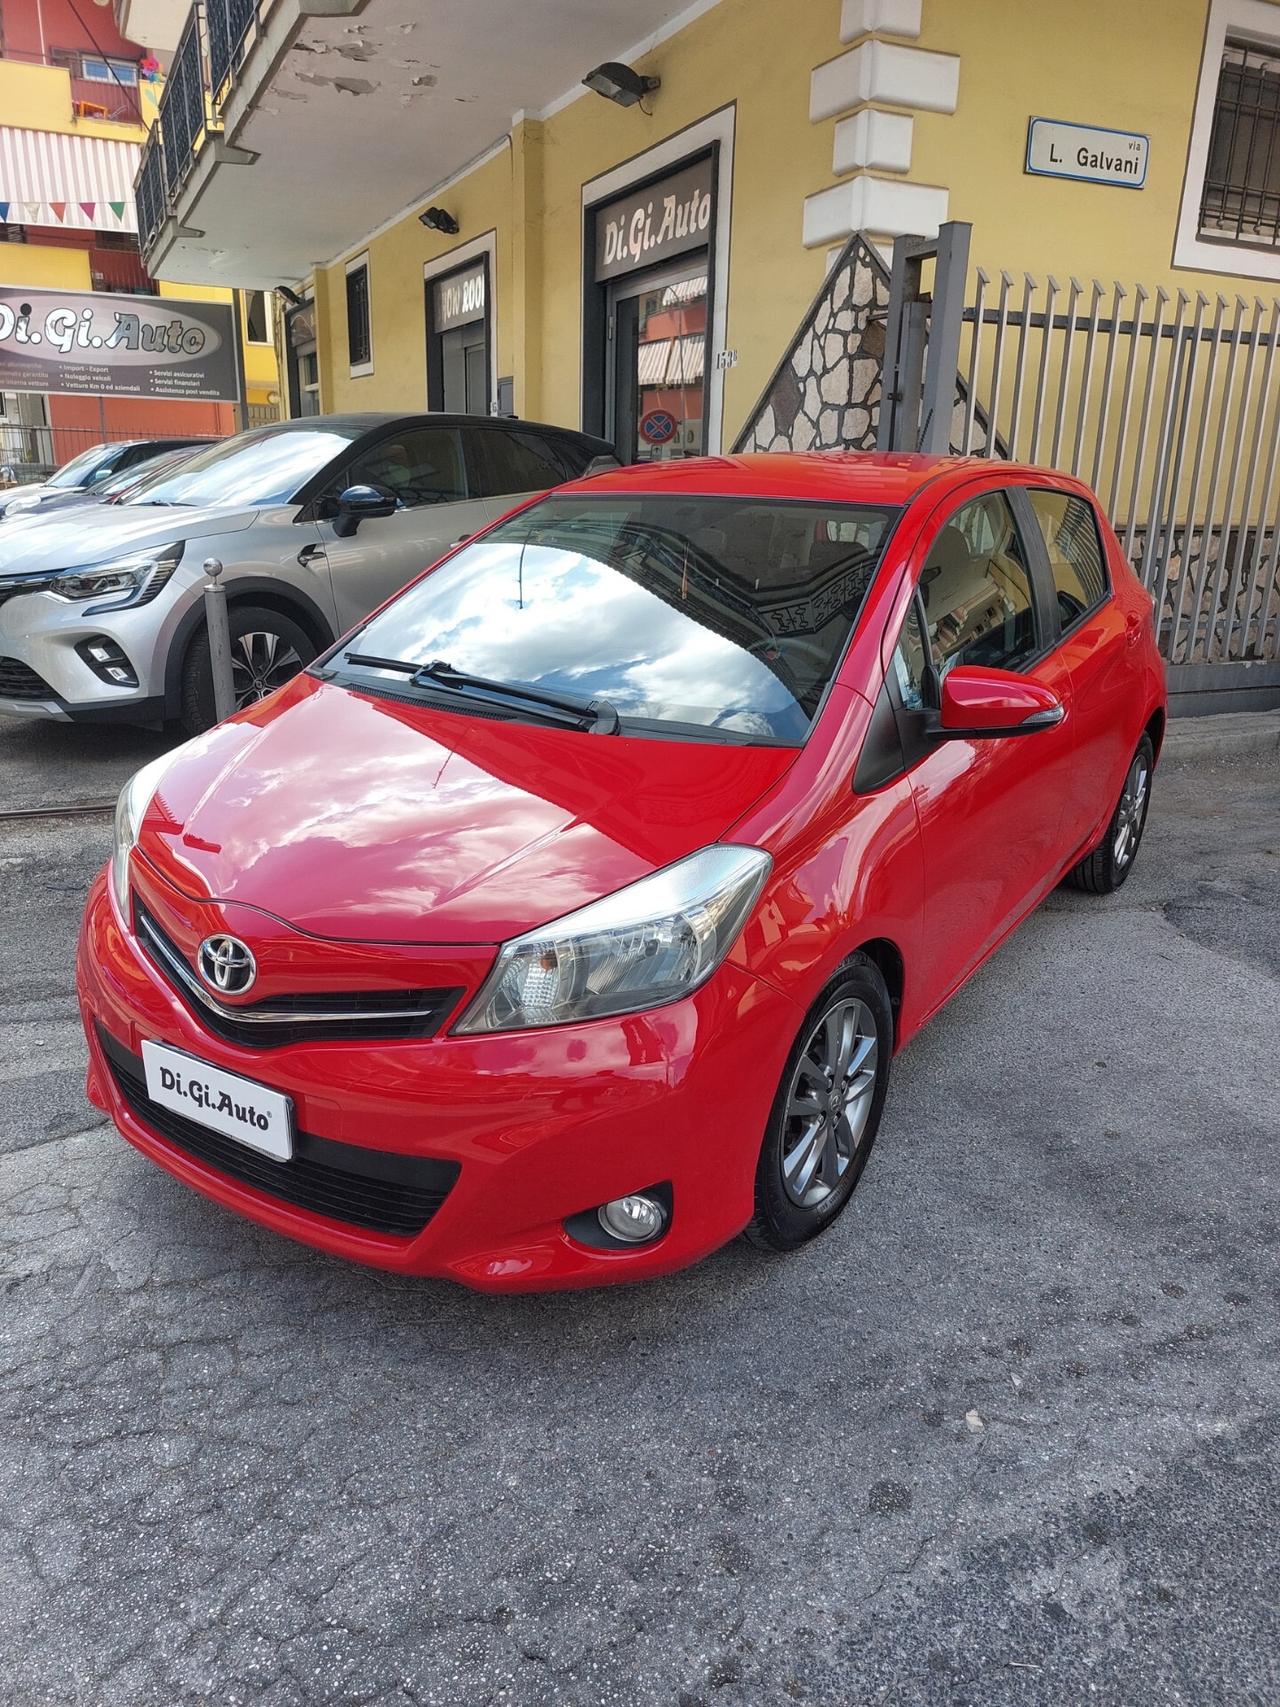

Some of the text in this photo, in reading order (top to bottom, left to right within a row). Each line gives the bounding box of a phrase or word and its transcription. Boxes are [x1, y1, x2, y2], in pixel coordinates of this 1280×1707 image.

[1128, 141, 1141, 151] via
[1049, 143, 1139, 174] L. Galvani
[603, 188, 712, 265] Di.Gi.Auto
[63, 364, 85, 372] Import
[89, 365, 109, 373] Export
[64, 373, 91, 381] Noleggio
[154, 369, 204, 378] Servizi assicurativi
[114, 384, 141, 392] aziendali
[155, 386, 185, 394] Assistenza
[159, 1066, 270, 1131] Di.Gi.Auto
